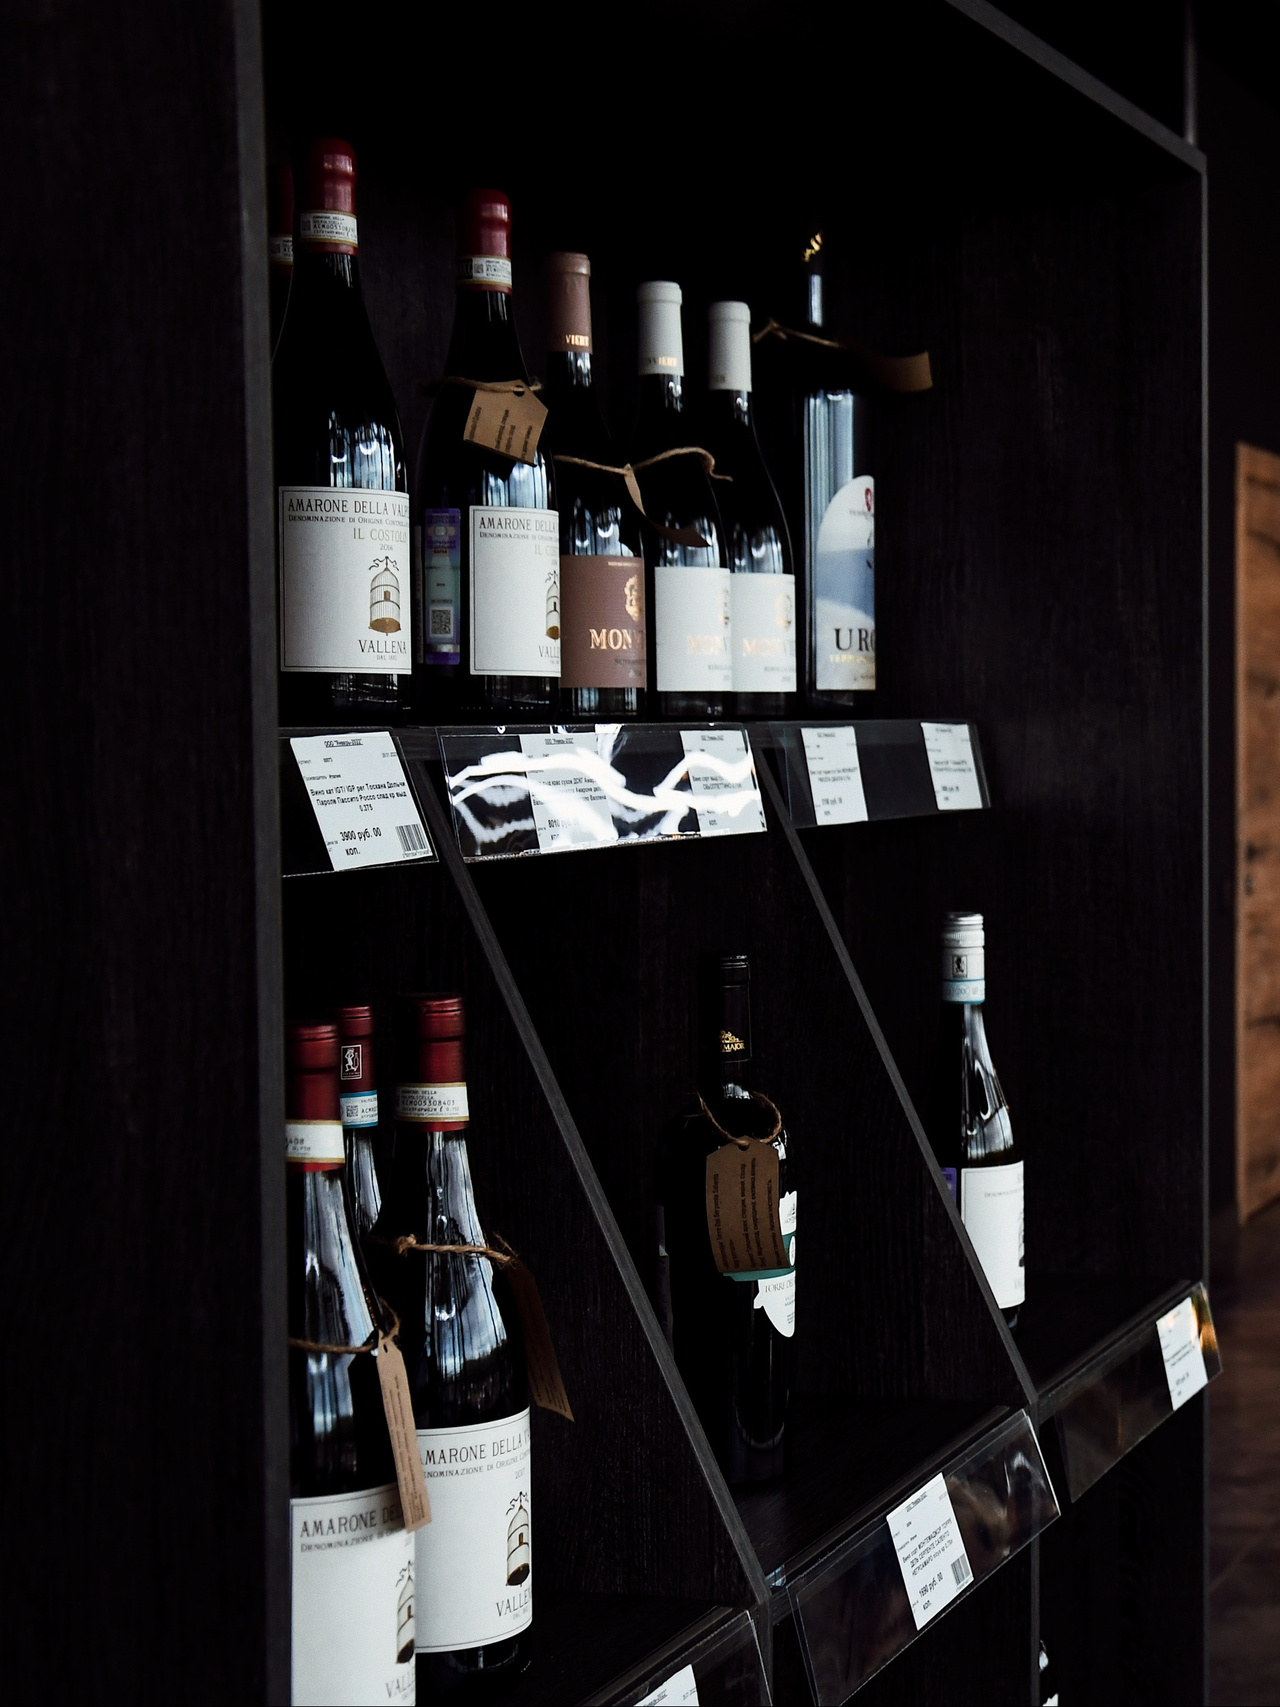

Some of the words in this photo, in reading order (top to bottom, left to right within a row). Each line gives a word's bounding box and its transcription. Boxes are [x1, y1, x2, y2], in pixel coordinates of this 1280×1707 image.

[288, 499, 348, 513] AMARONE
[354, 501, 389, 515] DELLA
[479, 516, 532, 531] AMARONE
[353, 528, 365, 539] IL
[358, 639, 406, 654] VALLENA
[339, 830, 357, 842] 3900
[357, 828, 372, 841] руб.
[372, 827, 382, 837] 00
[345, 847, 361, 856] коп.
[421, 1444, 486, 1466] MARONE
[492, 1433, 522, 1457] DELLA
[423, 1466, 483, 1479] ENOMINAZIONE
[300, 1509, 378, 1538] AMARONE
